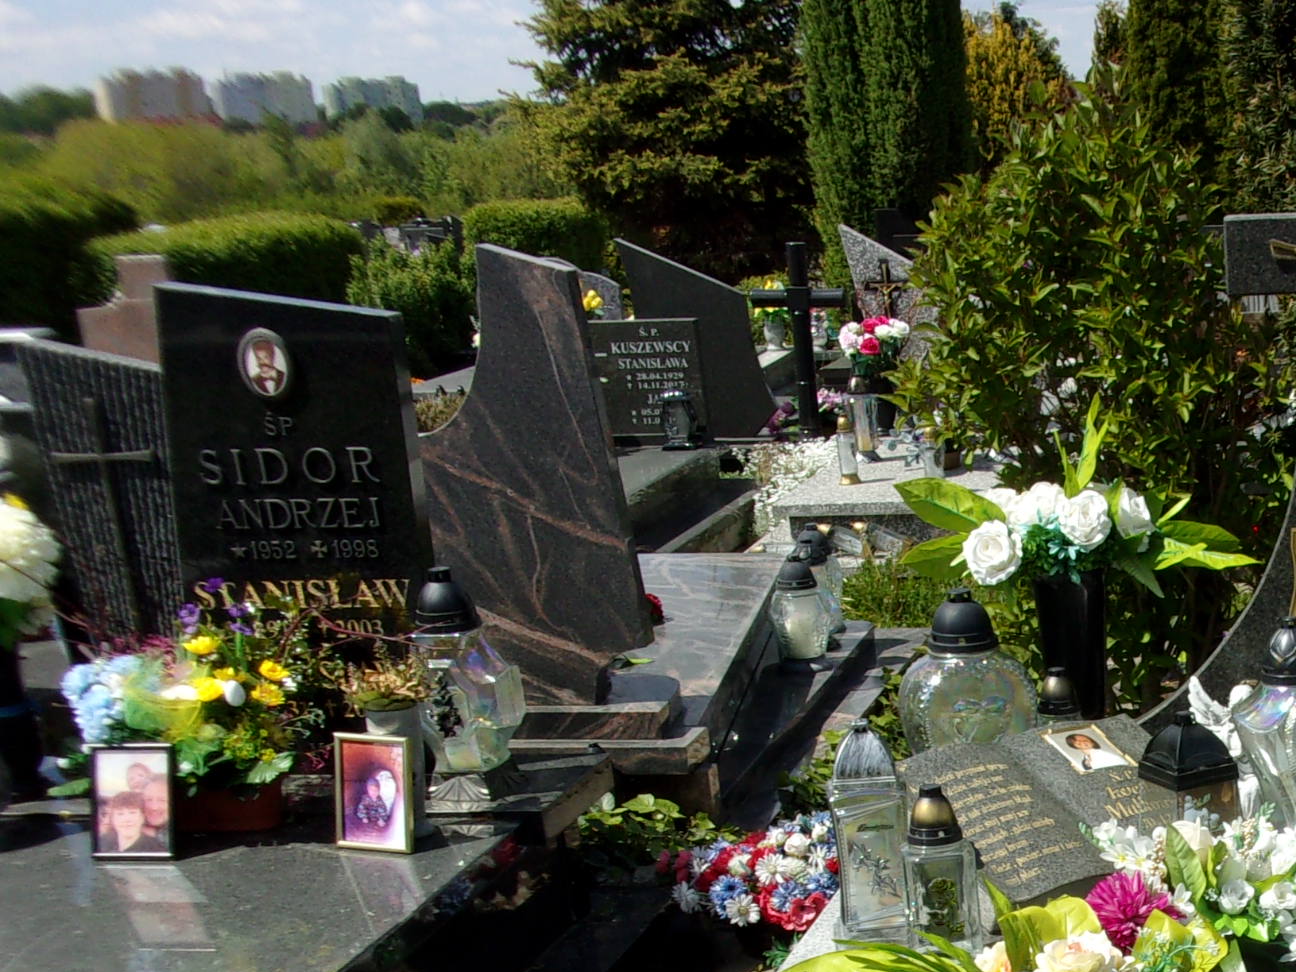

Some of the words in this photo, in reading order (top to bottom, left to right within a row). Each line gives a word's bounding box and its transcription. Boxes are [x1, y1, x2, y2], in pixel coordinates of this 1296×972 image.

[611, 341, 690, 354] KUSZEWSCY
[200, 447, 381, 485] SIDOR
[216, 497, 381, 530] ANDRZEJ
[249, 540, 297, 559] 1952
[332, 539, 380, 559] 1998
